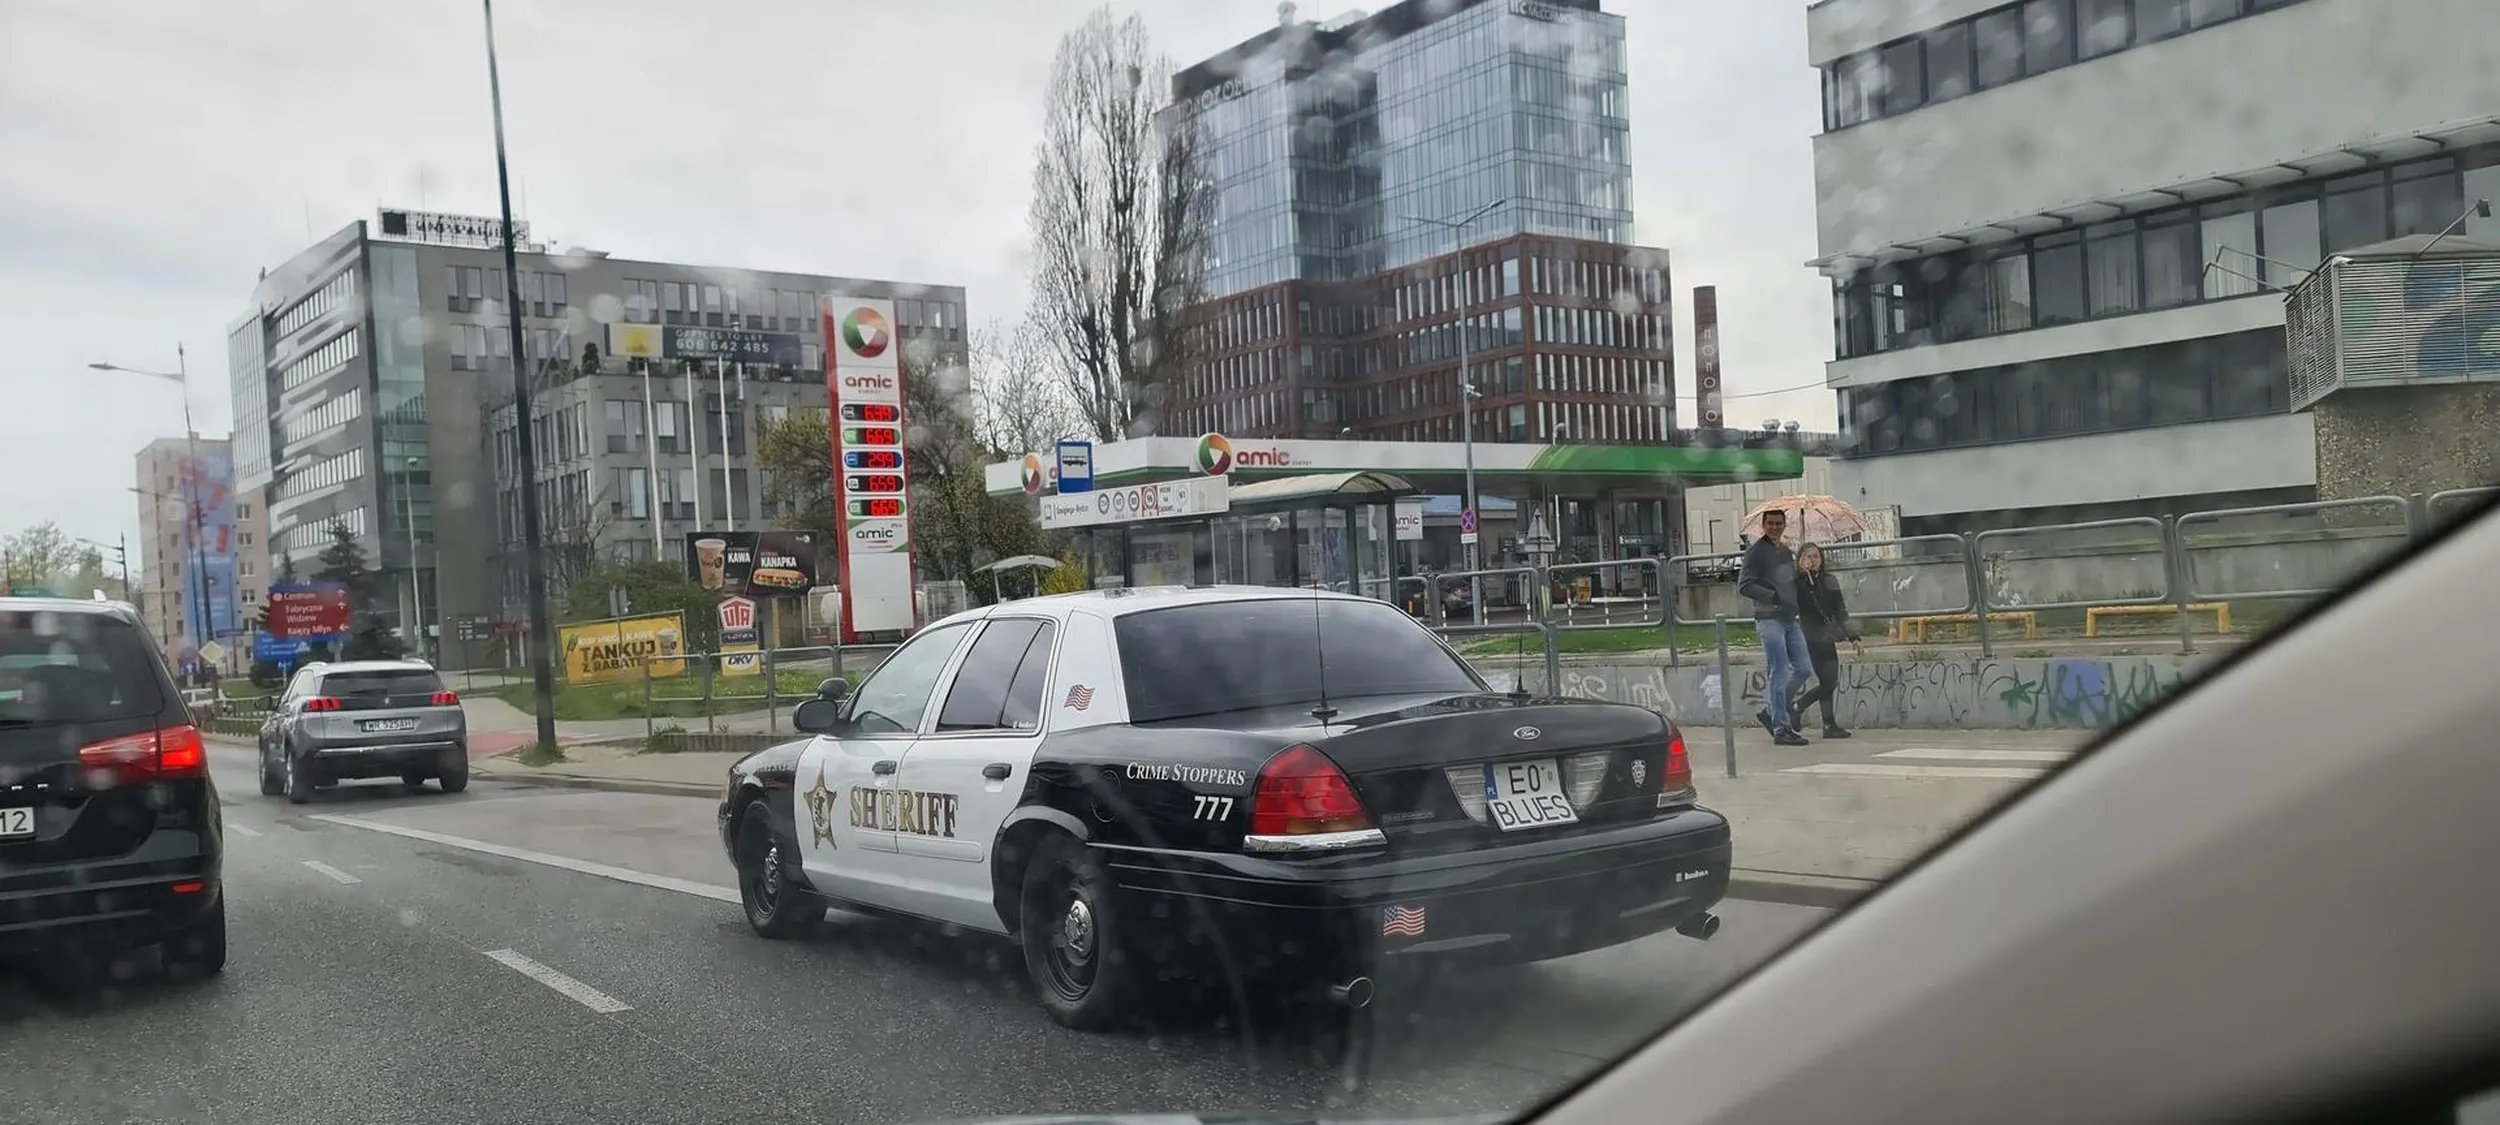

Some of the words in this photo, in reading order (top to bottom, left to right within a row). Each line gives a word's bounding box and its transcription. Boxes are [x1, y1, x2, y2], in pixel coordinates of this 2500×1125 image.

[710, 341, 737, 352] 642
[743, 342, 770, 353] 485
[845, 374, 892, 388] amic
[866, 428, 893, 445] 669
[868, 452, 894, 469] 299
[1237, 447, 1290, 466] amic
[869, 475, 896, 492] 659
[871, 500, 897, 517] 669
[1397, 515, 1420, 525] mic
[856, 527, 893, 539] amic
[727, 552, 751, 563] KAWA
[760, 556, 797, 568] KANAPKA
[722, 600, 751, 627] UTA
[580, 640, 656, 662] TANKUJ
[728, 654, 753, 665] DKV
[582, 663, 591, 673] Z
[1486, 786, 1496, 796] PL
[850, 784, 959, 838] SHERIFF
[1194, 795, 1234, 821] 777
[1493, 794, 1571, 826] BLUES
